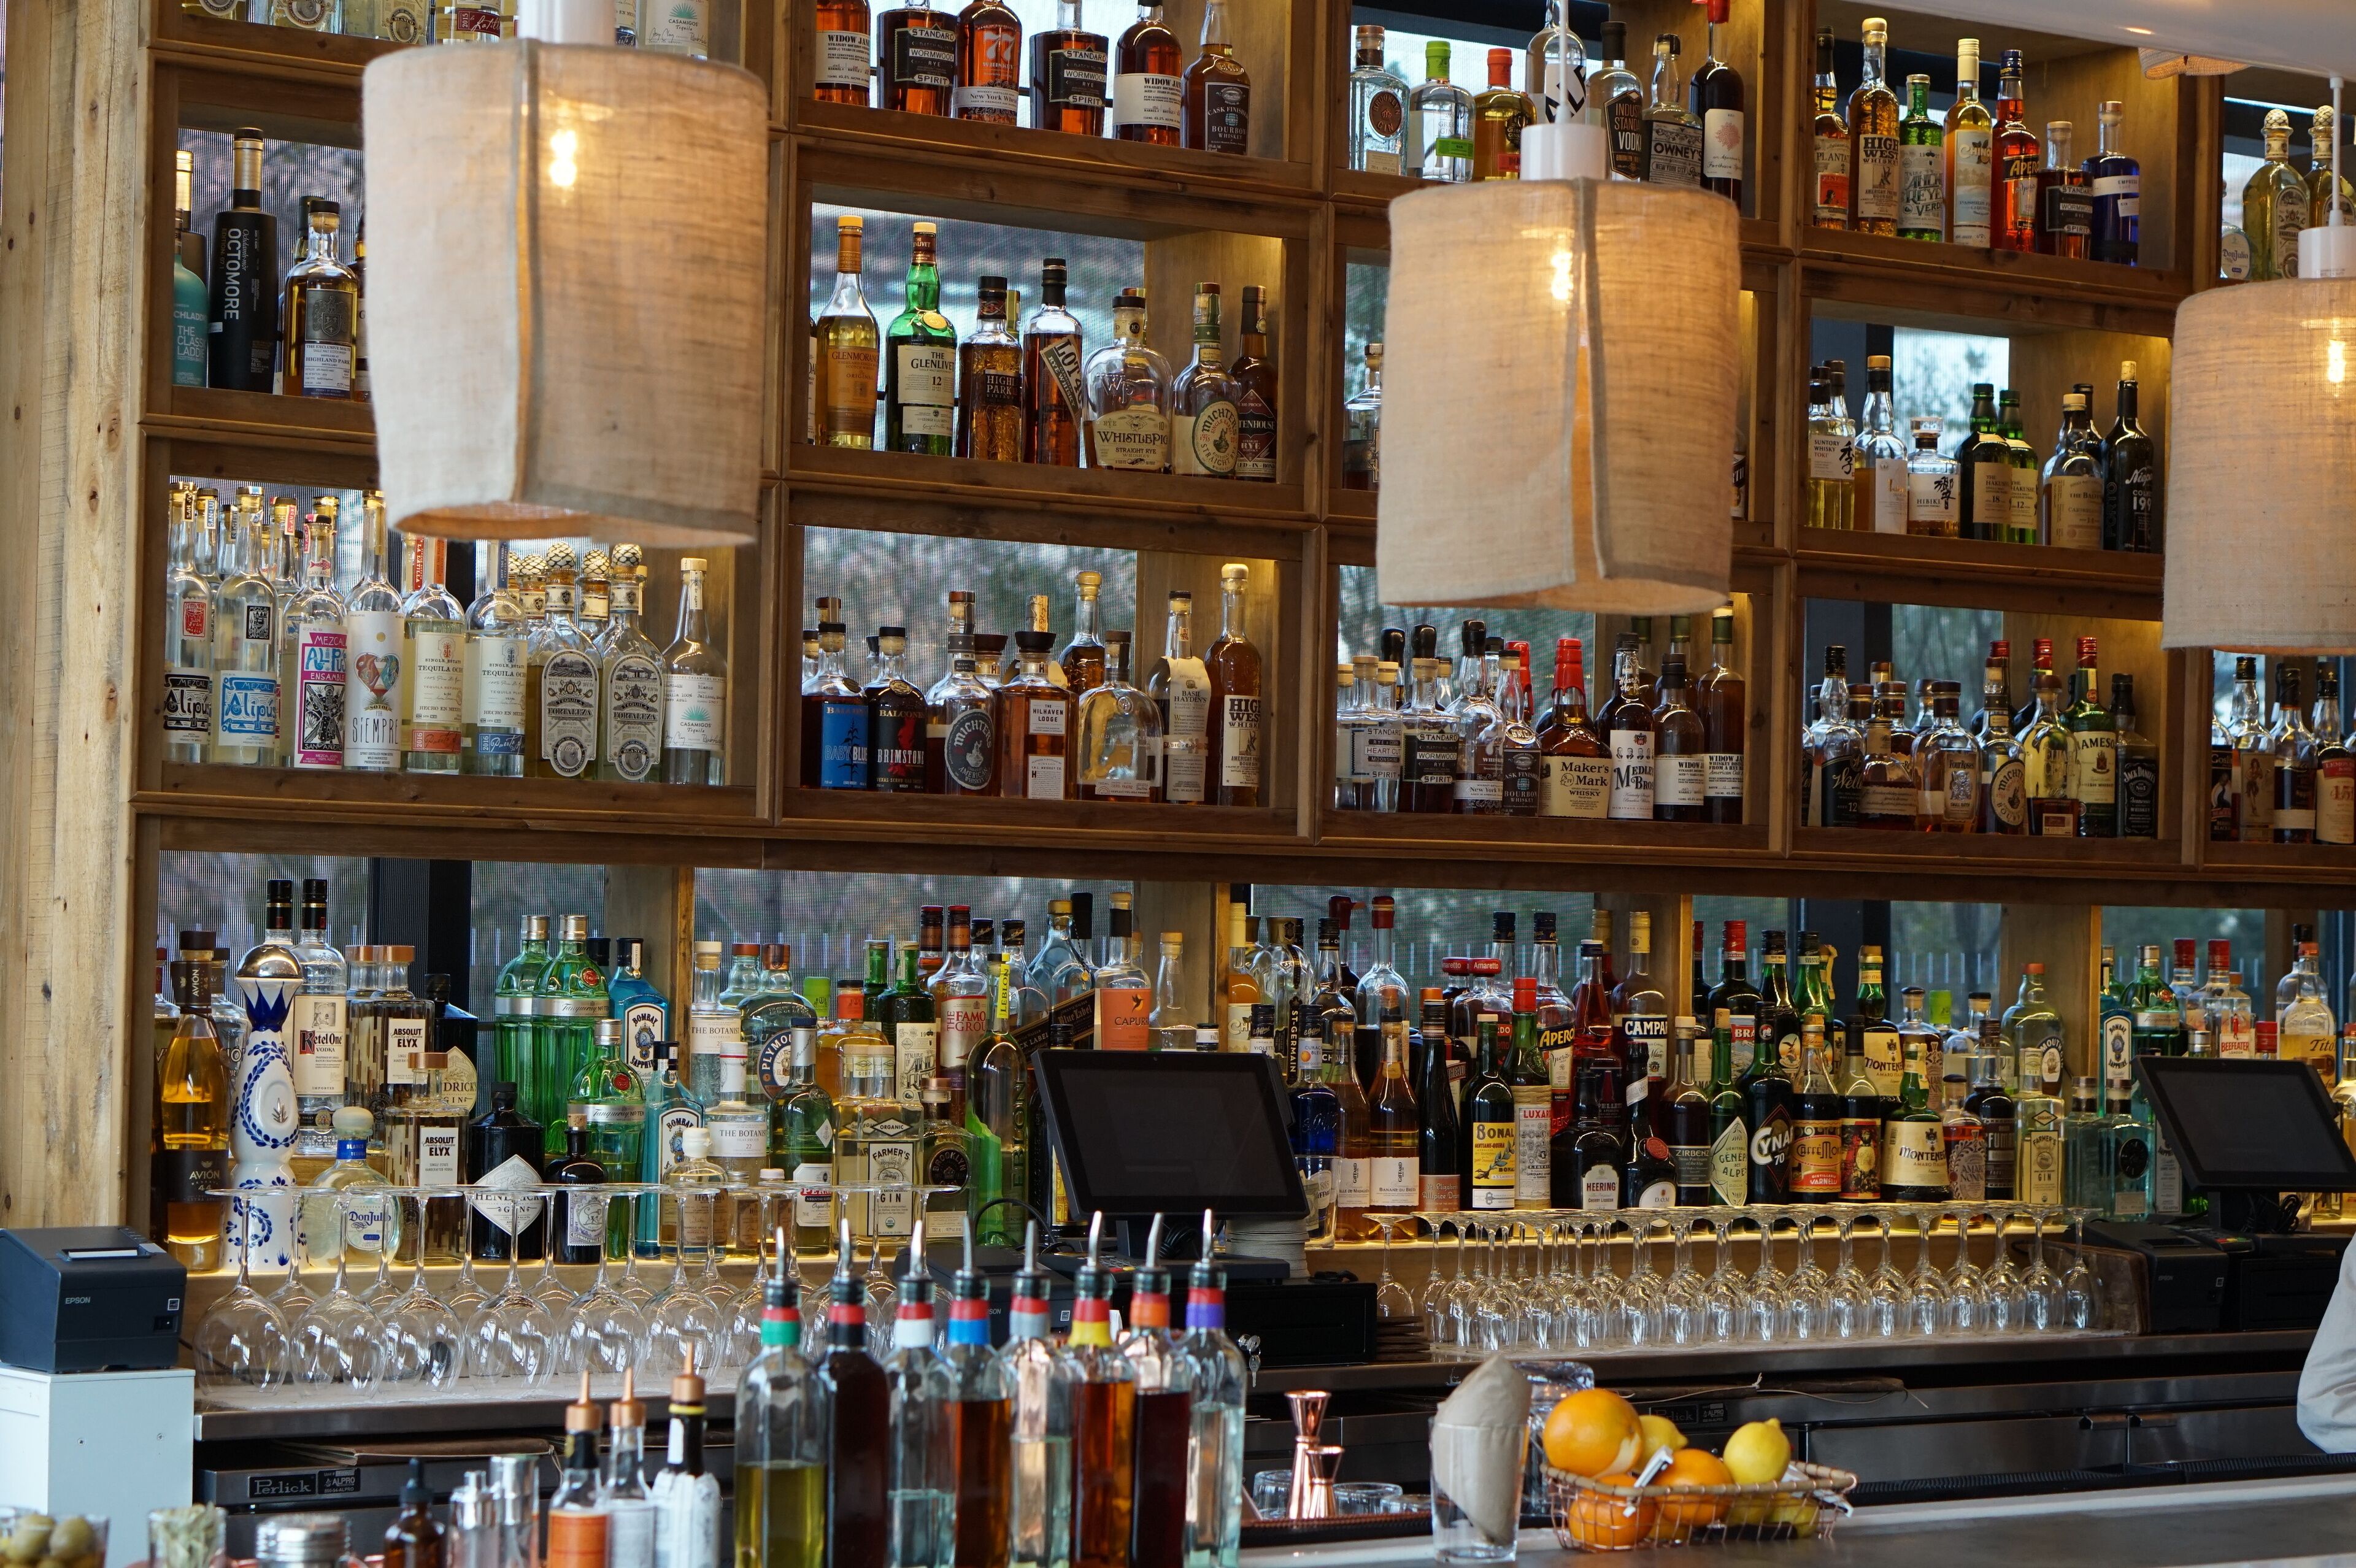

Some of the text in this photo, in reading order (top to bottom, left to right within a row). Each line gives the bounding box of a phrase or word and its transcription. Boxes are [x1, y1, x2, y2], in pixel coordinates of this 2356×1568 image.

[828, 34, 855, 44] WIDOW
[912, 29, 955, 42] STANDARD
[983, 31, 1015, 61] 77
[910, 48, 955, 60] WORMWOOD
[1067, 50, 1107, 63] STANDARD
[917, 75, 949, 86] SPIRIT
[1066, 70, 1107, 83] WORMWOOD
[1144, 77, 1169, 89] WIDOW
[970, 92, 1003, 102] New York
[1072, 95, 1102, 107] SPIRIT
[1372, 94, 1401, 115] BROOKLYN
[1207, 110, 1226, 122] CASK
[1212, 126, 1247, 135] BOURBON
[1377, 122, 1394, 133] GIN
[1863, 137, 1899, 150] HIGH
[1863, 149, 1899, 160] WEST
[1656, 166, 1686, 179] NEW YORK CITY
[2010, 160, 2040, 177] APERO
[2065, 225, 2089, 234] SPIRIT
[224, 228, 242, 320] OCTOMORE
[177, 326, 195, 336] THE
[931, 352, 945, 361] THE
[931, 376, 942, 389] 12
[986, 384, 1013, 396] PARK
[1241, 442, 1261, 450] RYE
[1992, 494, 2001, 504] 18
[2017, 500, 2025, 509] 12
[314, 635, 347, 648] MEZCAL
[417, 665, 451, 674] TEQUILA
[482, 669, 515, 678] TEQUILA
[177, 678, 206, 688] MEZCAL
[241, 682, 272, 692] MEZCAL
[555, 698, 583, 707] TEQUILA
[622, 702, 649, 712] TEQUILA
[1368, 728, 1401, 736] STANDARD
[1419, 734, 1458, 742] STANDARD
[825, 746, 868, 761] BABY BLUE
[877, 748, 924, 764] BRIMSTONE
[1366, 747, 1390, 756] HEART
[1417, 751, 1456, 761] WORMWOOD
[1560, 761, 1609, 775] Maker's
[1372, 771, 1398, 779] SPIRIT
[1423, 775, 1450, 783] SPIRIT
[1575, 775, 1609, 788] Mark
[1848, 802, 1858, 812] 12
[1474, 959, 1499, 969] Amaretto
[999, 969, 1010, 1013] LEBLON
[562, 1002, 598, 1013] Tanqueray
[631, 1013, 659, 1026] BOMBAY
[393, 1028, 422, 1040] ABSOLUT
[691, 1026, 740, 1035] THE BOTANIST
[1735, 1028, 1755, 1039] BRA
[2109, 1024, 2126, 1034] BOMBAY
[300, 1030, 342, 1055] Ketel One
[396, 1039, 418, 1048] ELYX
[1289, 1010, 1299, 1073] ST-GERMAIN
[1539, 1028, 1575, 1048] APERO
[2220, 1041, 2250, 1053] BEEFEATER
[2309, 1037, 2336, 1051] Tito
[593, 1109, 629, 1118] Tanqueray
[666, 1118, 695, 1132] BOMBAY
[720, 1129, 736, 1139] THE
[1476, 1124, 1515, 1141] BONAL
[425, 1136, 455, 1149] ABSOLUT
[2032, 1136, 2056, 1148] FARMER'S
[429, 1147, 450, 1156] ELYX
[872, 1148, 911, 1161] FARMER'S
[932, 1150, 968, 1172] BROOKLYN
[1774, 1152, 1785, 1166] 70
[189, 1169, 220, 1180] AVIÓN
[2038, 1172, 2051, 1182] GIN
[1586, 1181, 1616, 1191] HEERING
[880, 1193, 902, 1204] GIN
[65, 1296, 91, 1305] EPSON
[332, 1476, 356, 1485] ALPRO
[254, 1479, 312, 1495] Perlick
